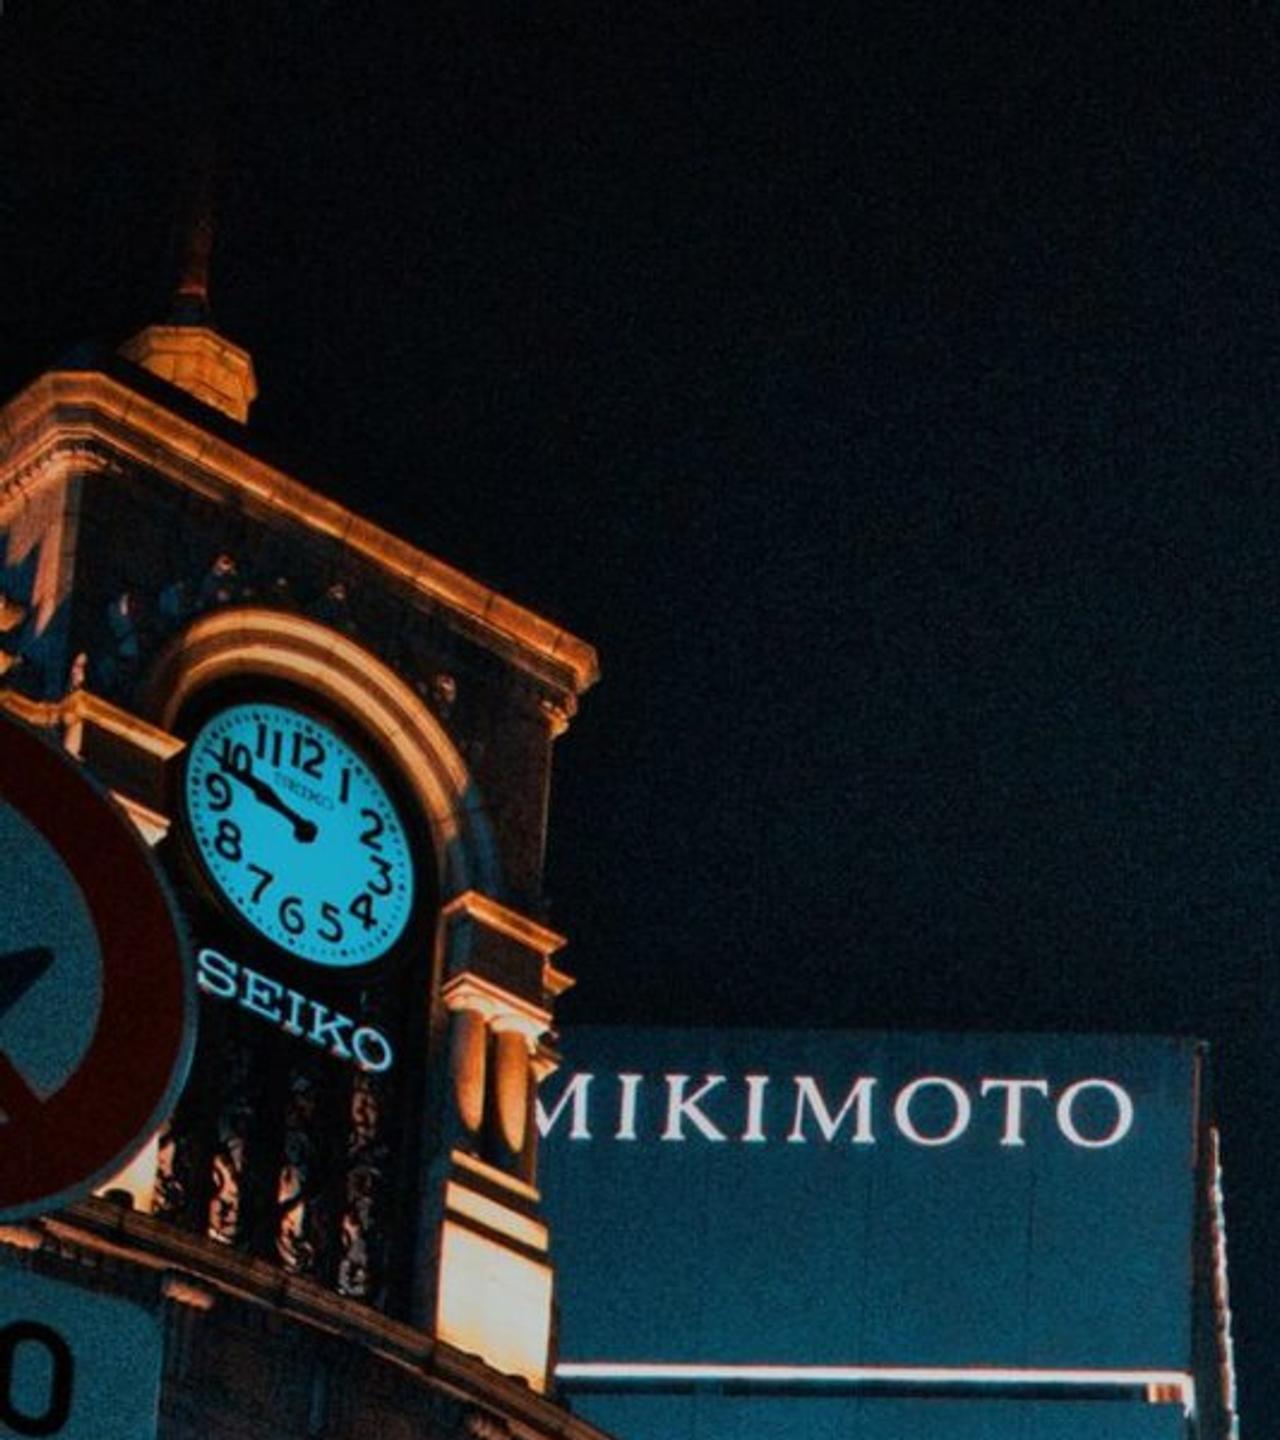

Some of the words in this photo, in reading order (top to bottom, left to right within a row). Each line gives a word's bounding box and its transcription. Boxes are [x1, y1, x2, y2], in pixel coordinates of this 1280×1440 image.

[292, 729, 327, 780] 12
[205, 772, 233, 812] 9
[339, 767, 350, 803] 1
[214, 820, 242, 862] 8
[360, 809, 384, 850] 2
[247, 864, 273, 904] 7
[368, 855, 393, 896] 3
[279, 896, 306, 935] 6
[318, 905, 344, 943] 5
[350, 894, 378, 930] 4
[197, 947, 393, 1073] SEIKO
